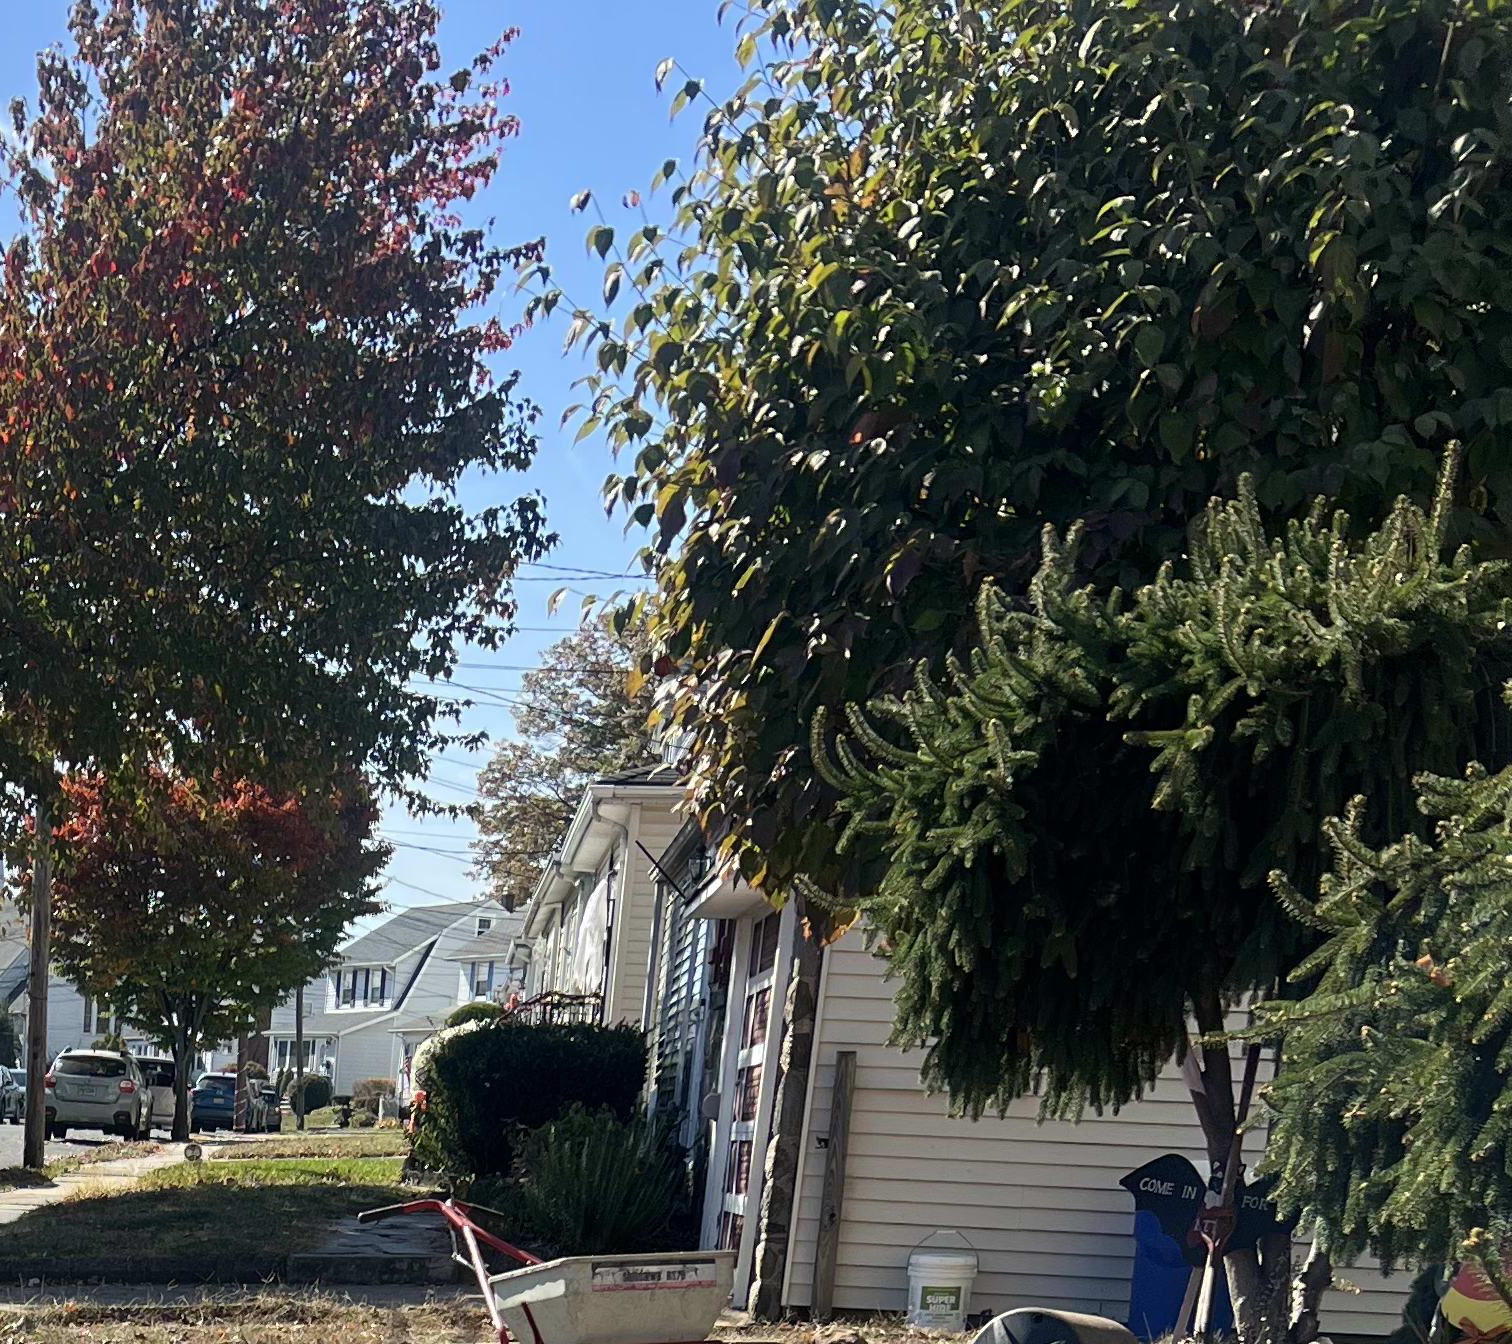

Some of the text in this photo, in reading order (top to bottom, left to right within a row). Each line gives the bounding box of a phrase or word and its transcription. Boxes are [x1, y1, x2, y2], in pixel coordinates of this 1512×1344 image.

[1139, 1177, 1175, 1196] COME
[1181, 1185, 1197, 1200] IN
[925, 1295, 956, 1304] SUPER
